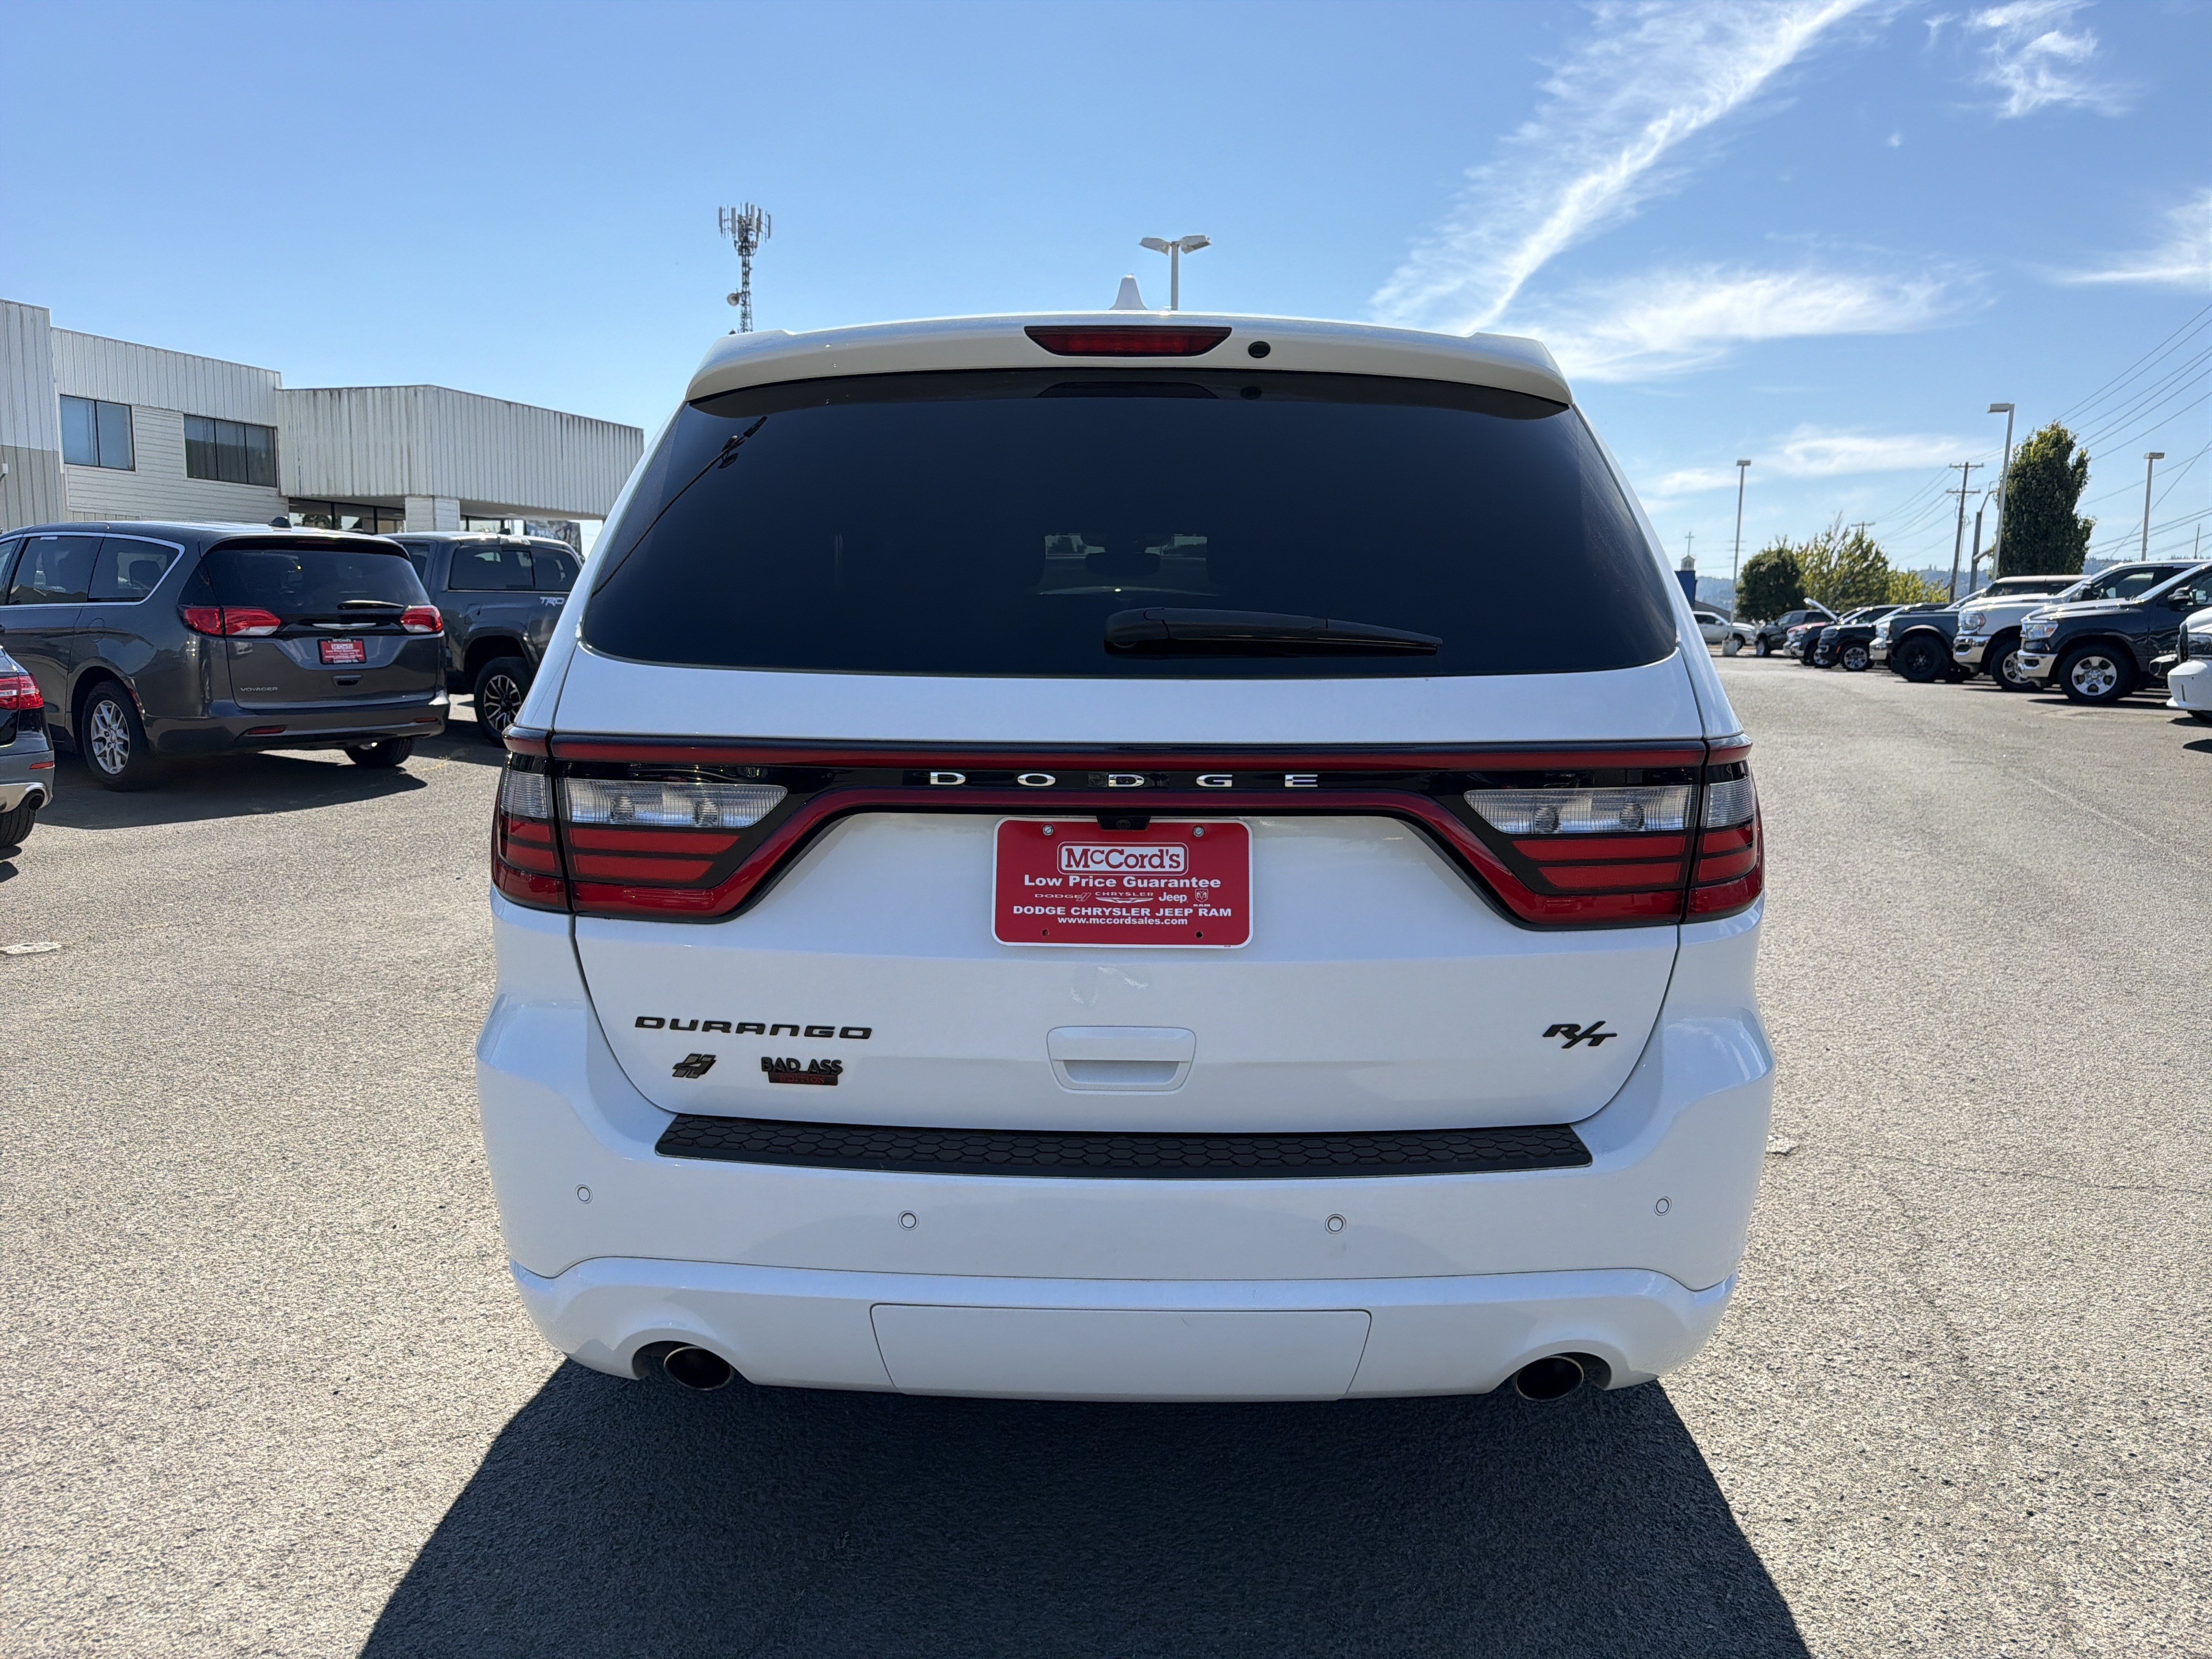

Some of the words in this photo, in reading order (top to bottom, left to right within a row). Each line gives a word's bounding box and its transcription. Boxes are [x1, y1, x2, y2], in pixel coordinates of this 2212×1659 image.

[929, 772, 1318, 788] DODGE
[1065, 848, 1182, 870] McCord's
[1024, 874, 1062, 887] Low
[1069, 875, 1117, 888] Price
[1122, 876, 1222, 888] Guarantee
[1158, 891, 1187, 904] Jeep
[1013, 905, 1066, 915] DODGE
[1070, 906, 1151, 916] CHRYSLER
[1155, 907, 1193, 917] JEEP
[1198, 908, 1232, 917] RAM
[1057, 916, 1188, 925] www.mccordsales.com
[634, 1016, 872, 1040] DURANGO
[1542, 1020, 1618, 1049] R/T
[761, 1057, 801, 1074] BAD
[808, 1058, 843, 1075] ASS
